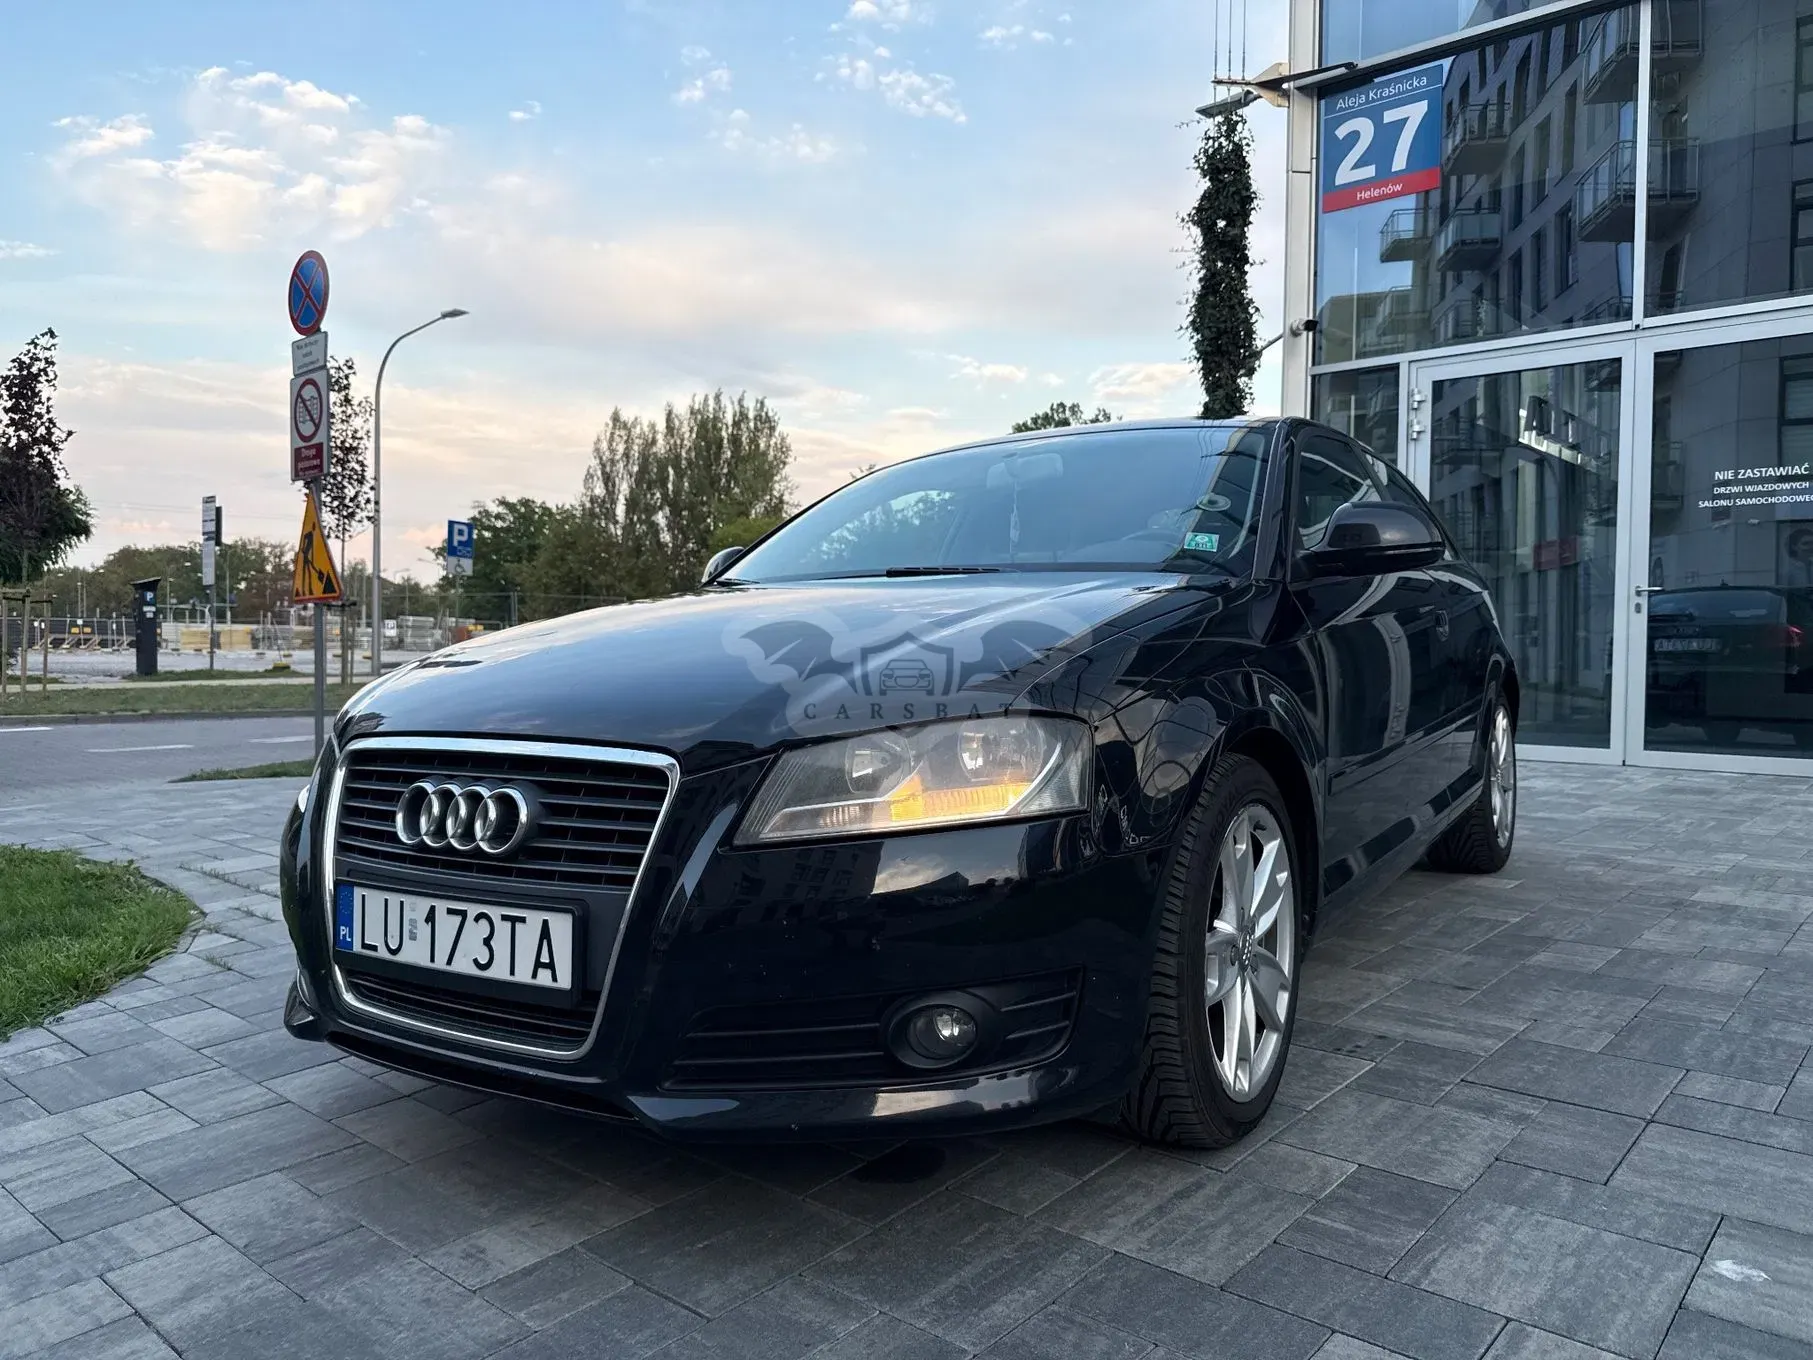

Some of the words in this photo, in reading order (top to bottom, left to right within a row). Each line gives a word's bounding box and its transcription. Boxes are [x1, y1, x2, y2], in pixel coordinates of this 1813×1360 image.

[1336, 92, 1366, 110] Aleja
[1368, 75, 1427, 99] Kraśnicka
[1335, 100, 1428, 186] 27
[1357, 183, 1403, 201] Helenów
[1714, 471, 1735, 480] NIE
[1737, 463, 1810, 479] ZASTAWIAĆ
[1713, 486, 1743, 494] DRZWI
[1744, 482, 1810, 492] WJAZDOWYCH
[1698, 499, 1734, 508] SALONU
[452, 523, 469, 547] P
[339, 925, 352, 942] PL
[361, 893, 405, 956] LU
[424, 904, 558, 983] 173TA
